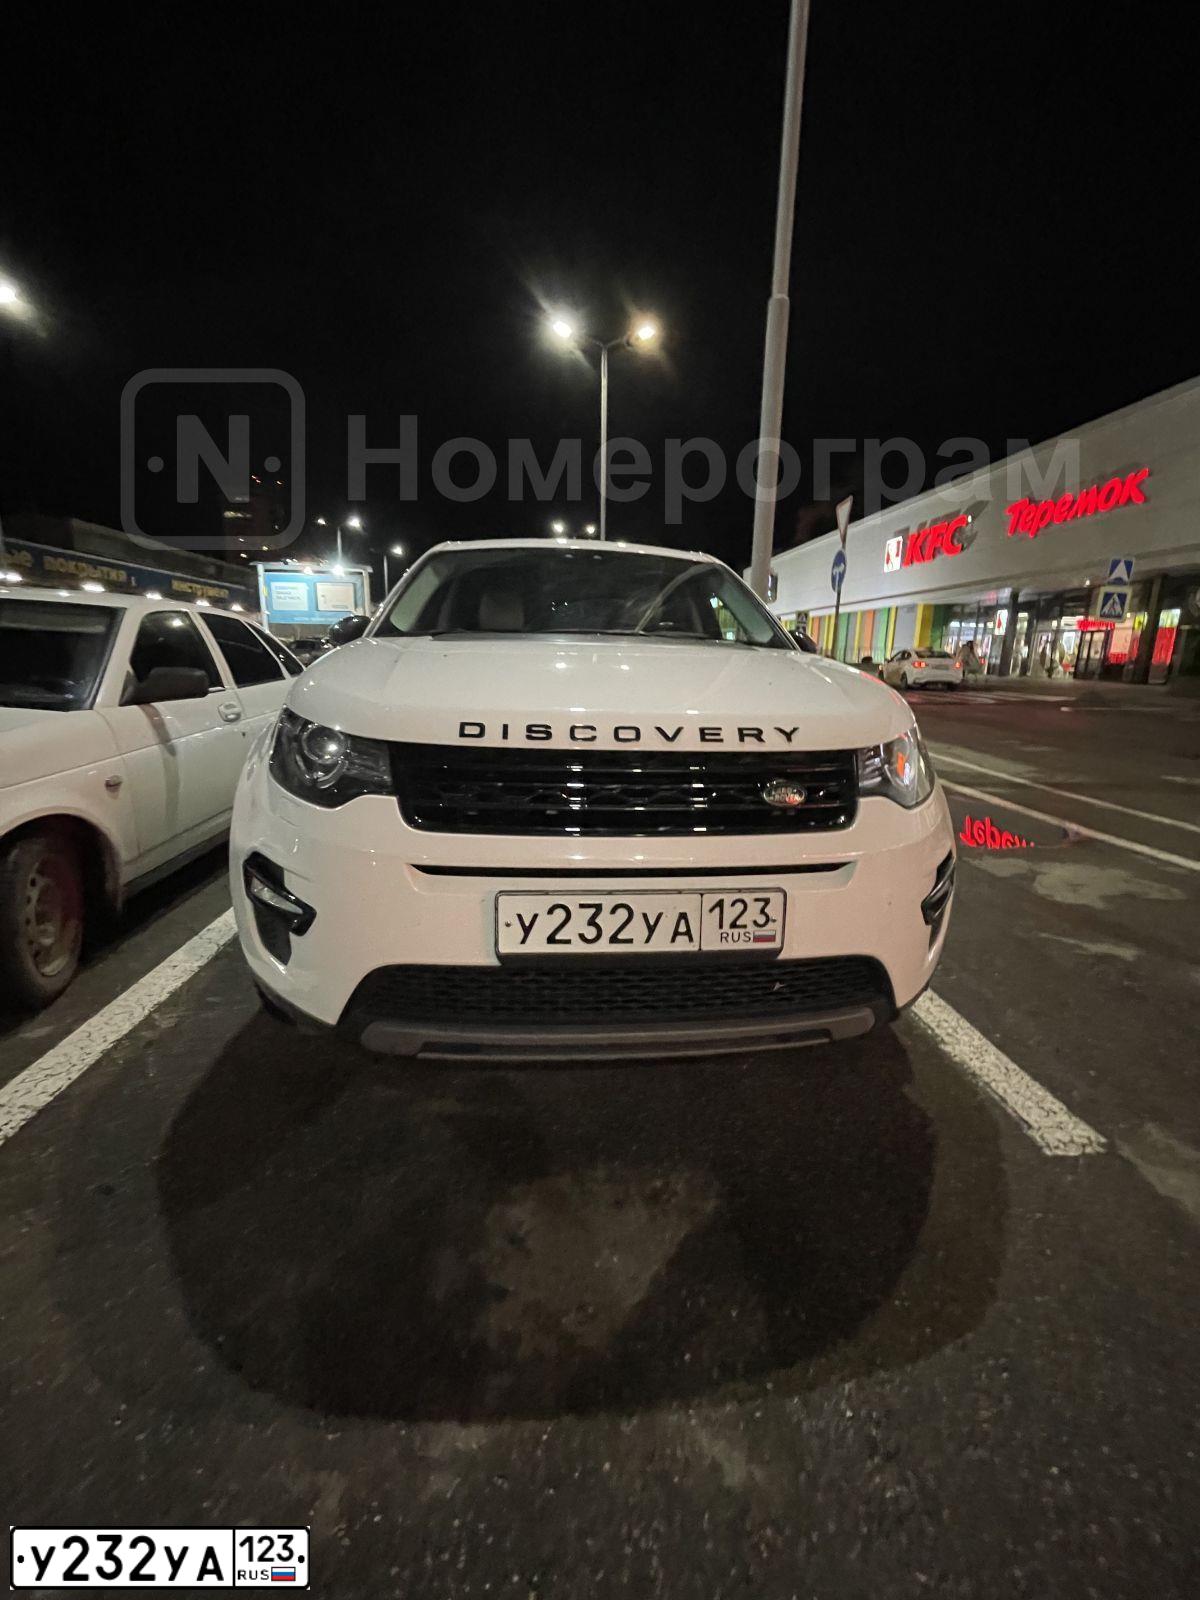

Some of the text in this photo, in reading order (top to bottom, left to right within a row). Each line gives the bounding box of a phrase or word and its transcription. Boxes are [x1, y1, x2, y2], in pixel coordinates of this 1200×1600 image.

[1004, 467, 1149, 538] Теремок
[901, 514, 968, 568] KFC
[458, 721, 800, 743] DISCOVERY
[516, 897, 771, 945] У232УА 123
[720, 931, 752, 943] RUS
